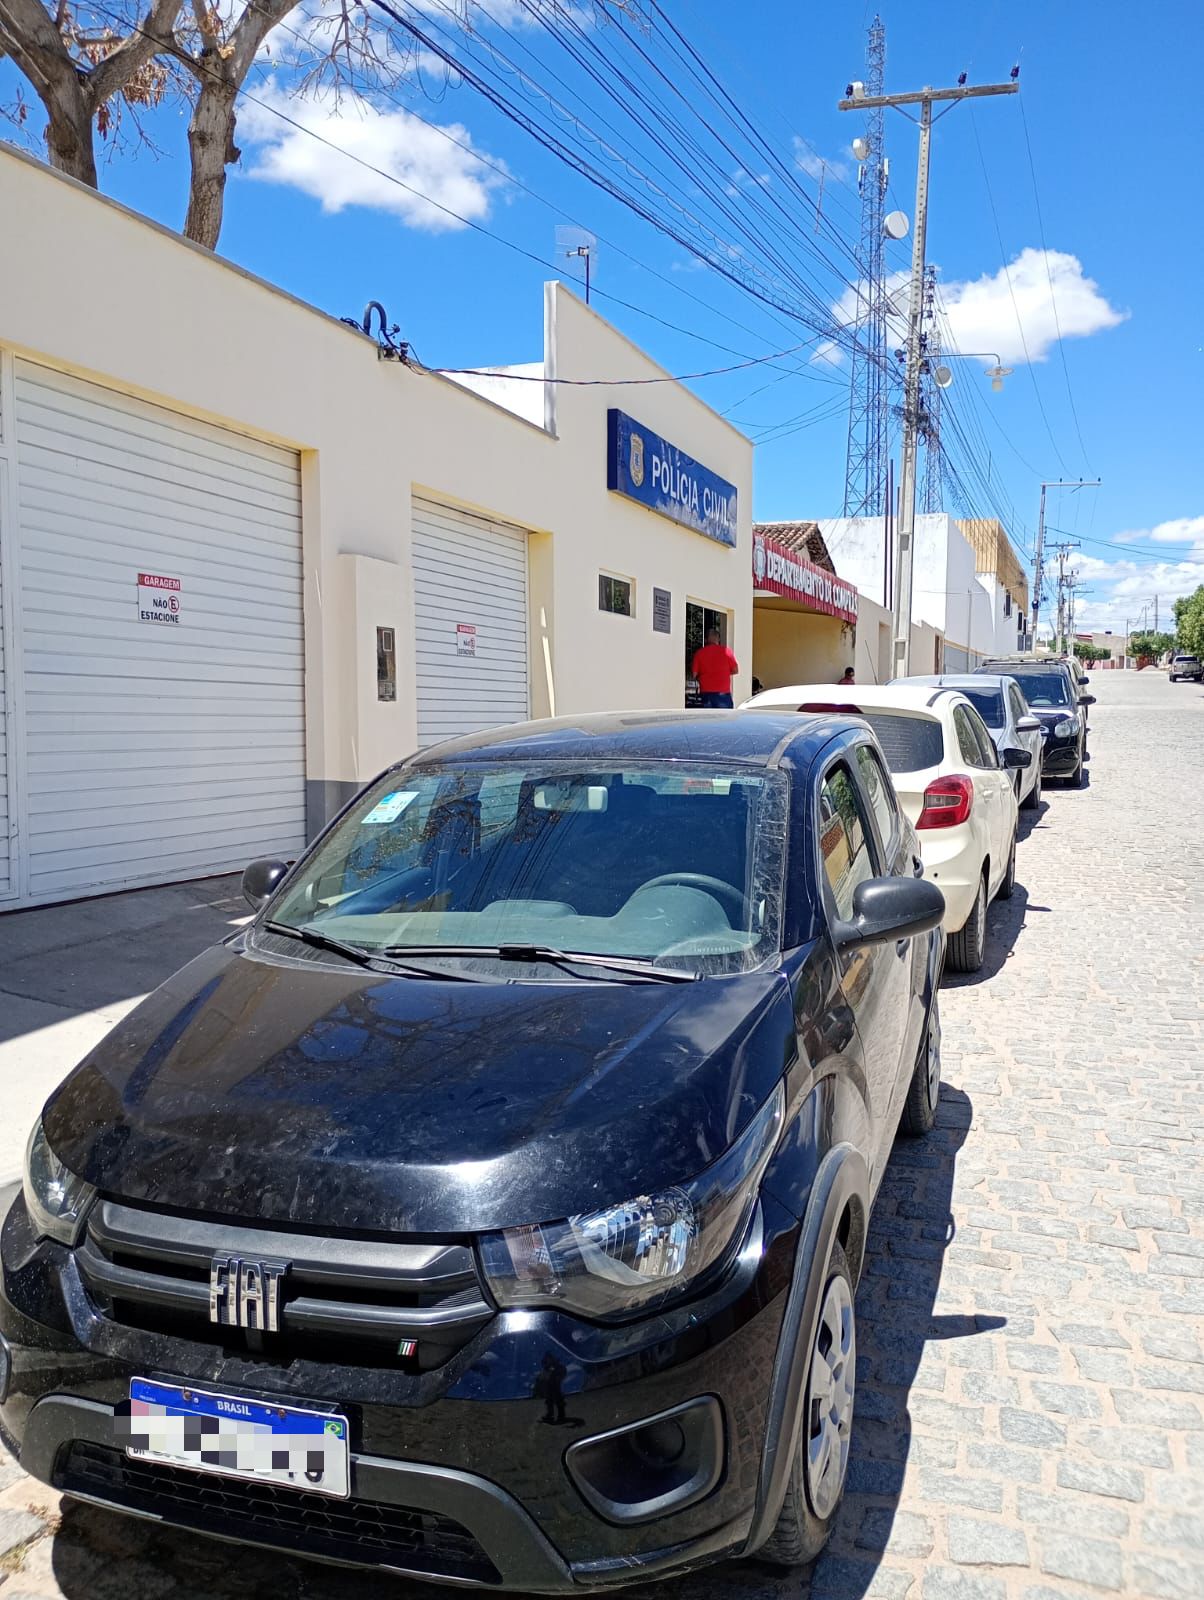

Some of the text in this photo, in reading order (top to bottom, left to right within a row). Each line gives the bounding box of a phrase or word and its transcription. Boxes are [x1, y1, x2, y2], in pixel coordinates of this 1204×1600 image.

[652, 454, 729, 527] POLÍCIA CIVIL
[144, 575, 180, 589] GARAGEM
[767, 549, 825, 601] DEPARTAMENTO
[153, 597, 167, 608] NÃO
[141, 611, 179, 623] ESTACIONE
[210, 1256, 286, 1332] FIAT
[216, 1400, 252, 1417] BRASIL
